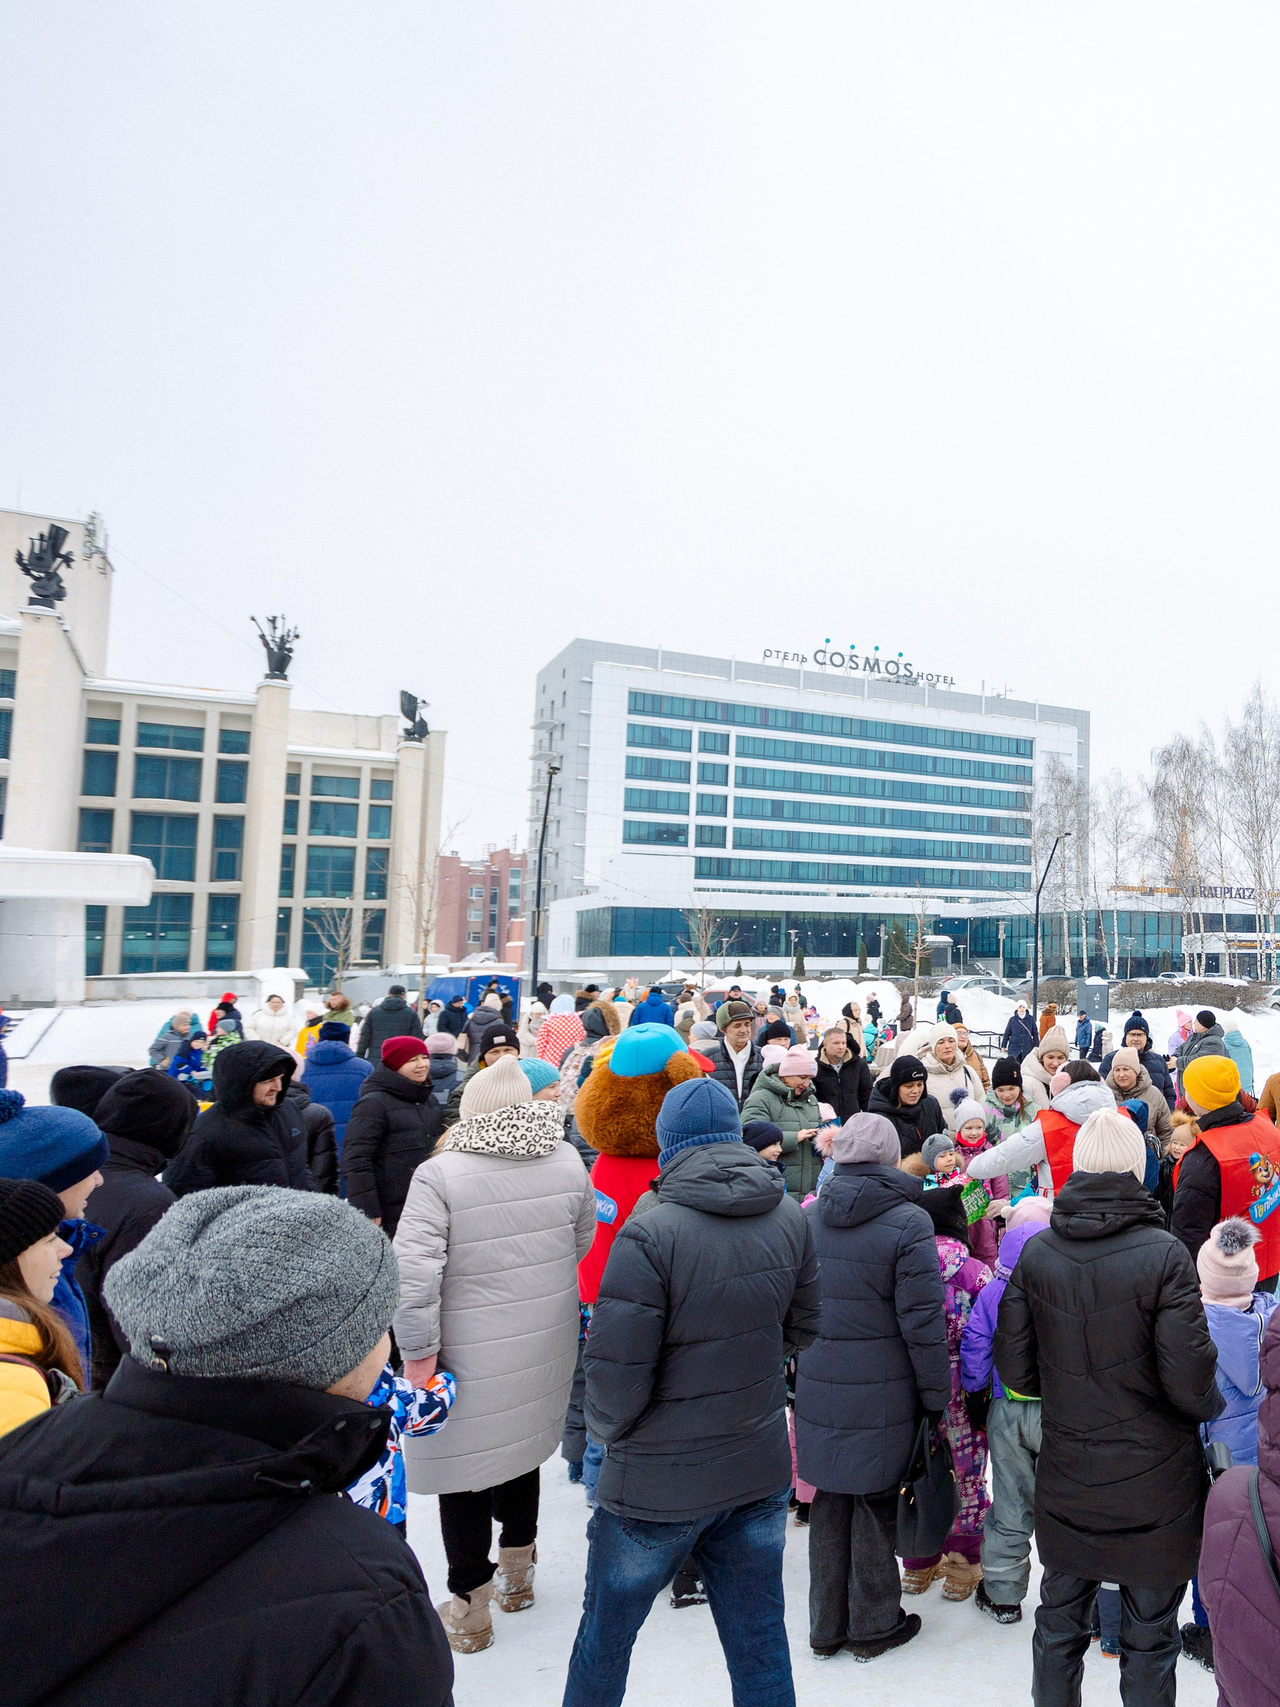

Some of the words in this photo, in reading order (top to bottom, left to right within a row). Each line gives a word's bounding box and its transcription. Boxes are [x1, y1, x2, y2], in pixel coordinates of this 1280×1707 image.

[763, 649, 808, 663] ОТЕЛЬ
[813, 649, 913, 678] COSMOS
[917, 671, 956, 686] HOTEL
